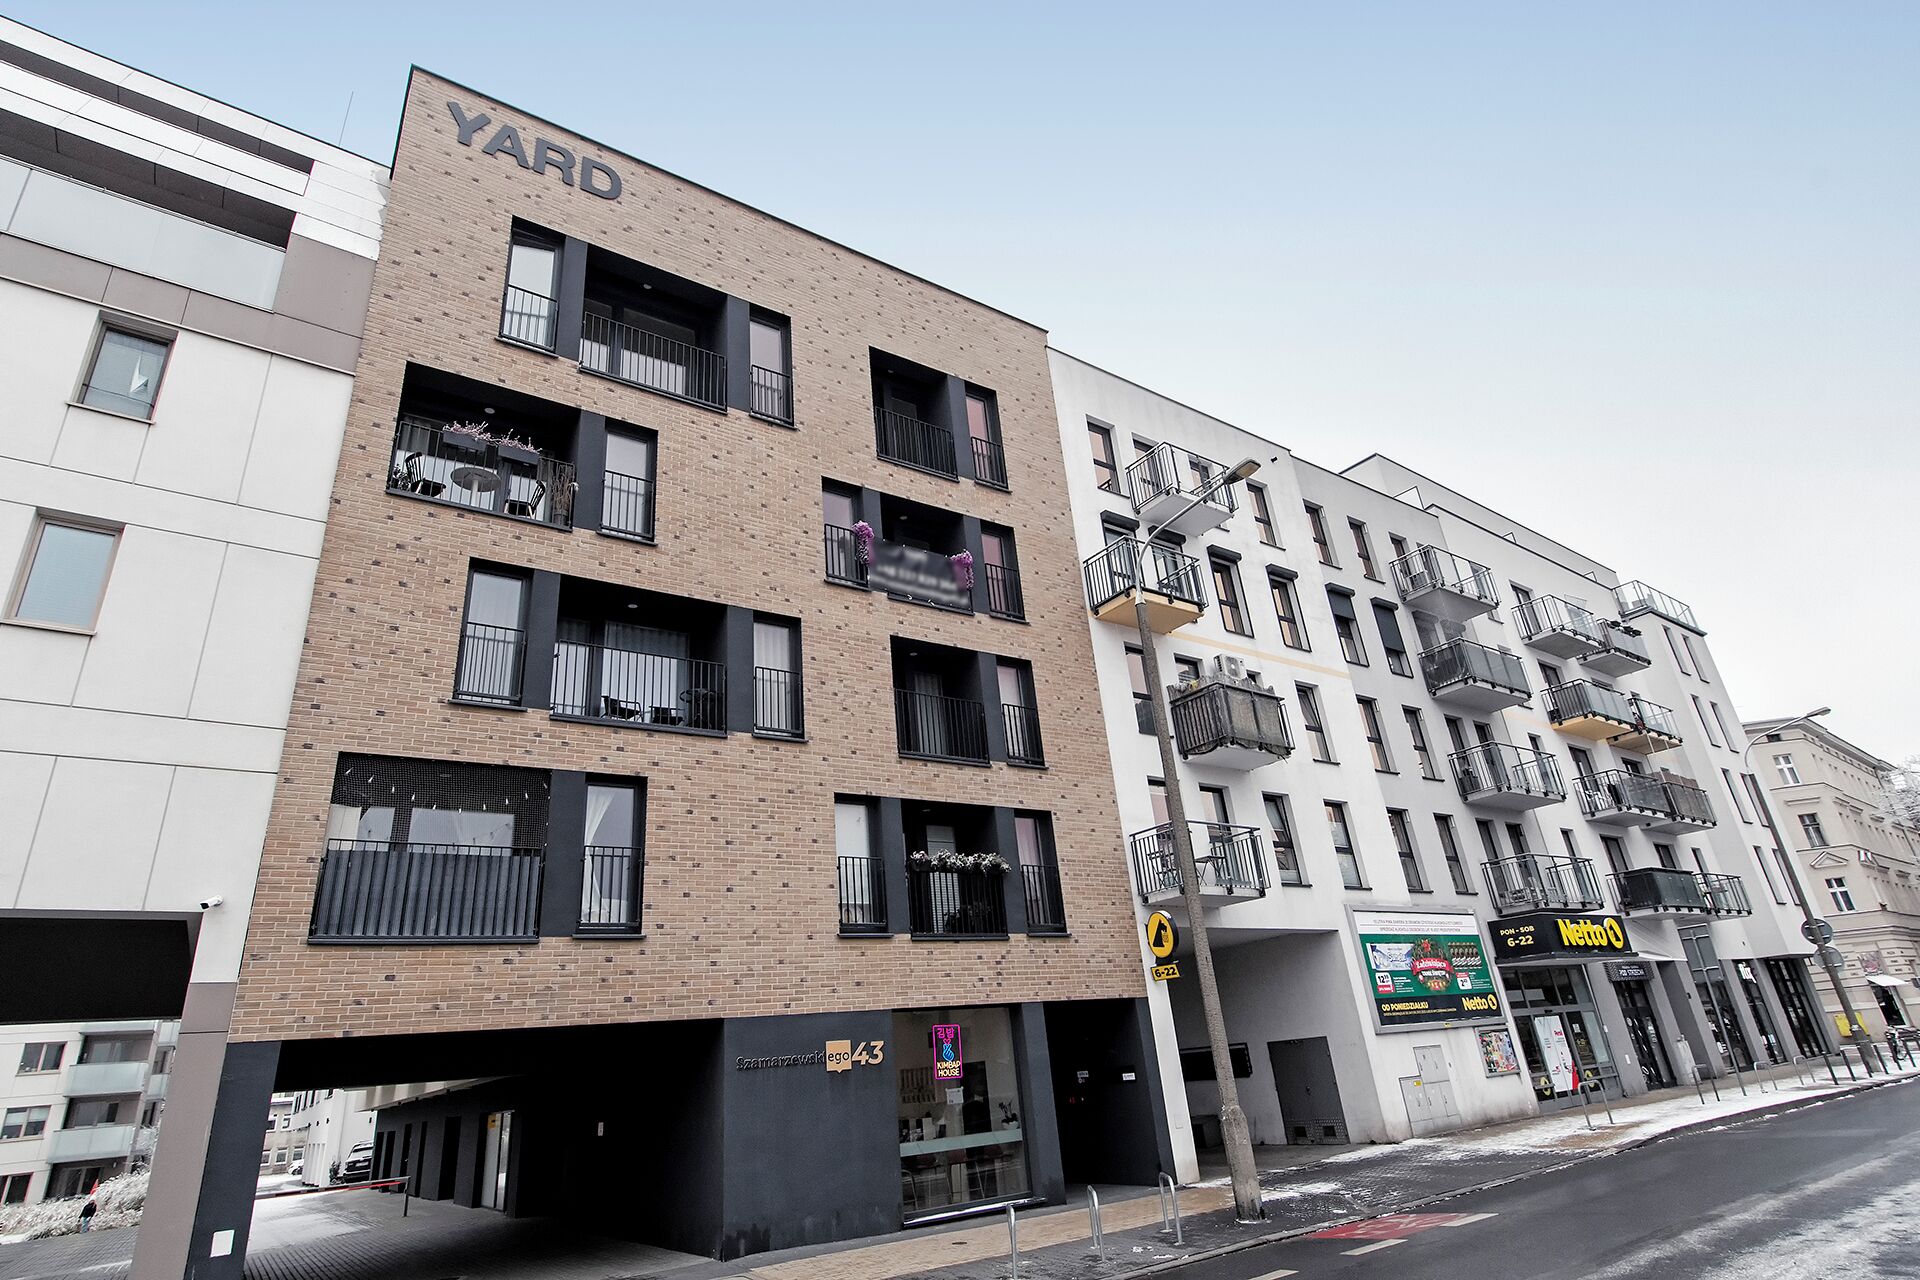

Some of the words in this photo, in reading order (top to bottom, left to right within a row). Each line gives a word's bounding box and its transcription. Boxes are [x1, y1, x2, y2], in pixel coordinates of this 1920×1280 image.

[447, 101, 622, 200] YARD
[1520, 925, 1535, 933] SOB
[1557, 918, 1608, 946] Netto
[1507, 935, 1534, 947] 6-22
[1154, 966, 1177, 977] 6-22
[1381, 1003, 1390, 1012] OD
[1461, 996, 1488, 1011] Netto
[937, 1027, 955, 1038] 김밥
[852, 1040, 885, 1066] 43
[937, 1061, 960, 1070] KIMBAP
[938, 1068, 960, 1077] HOUSE
